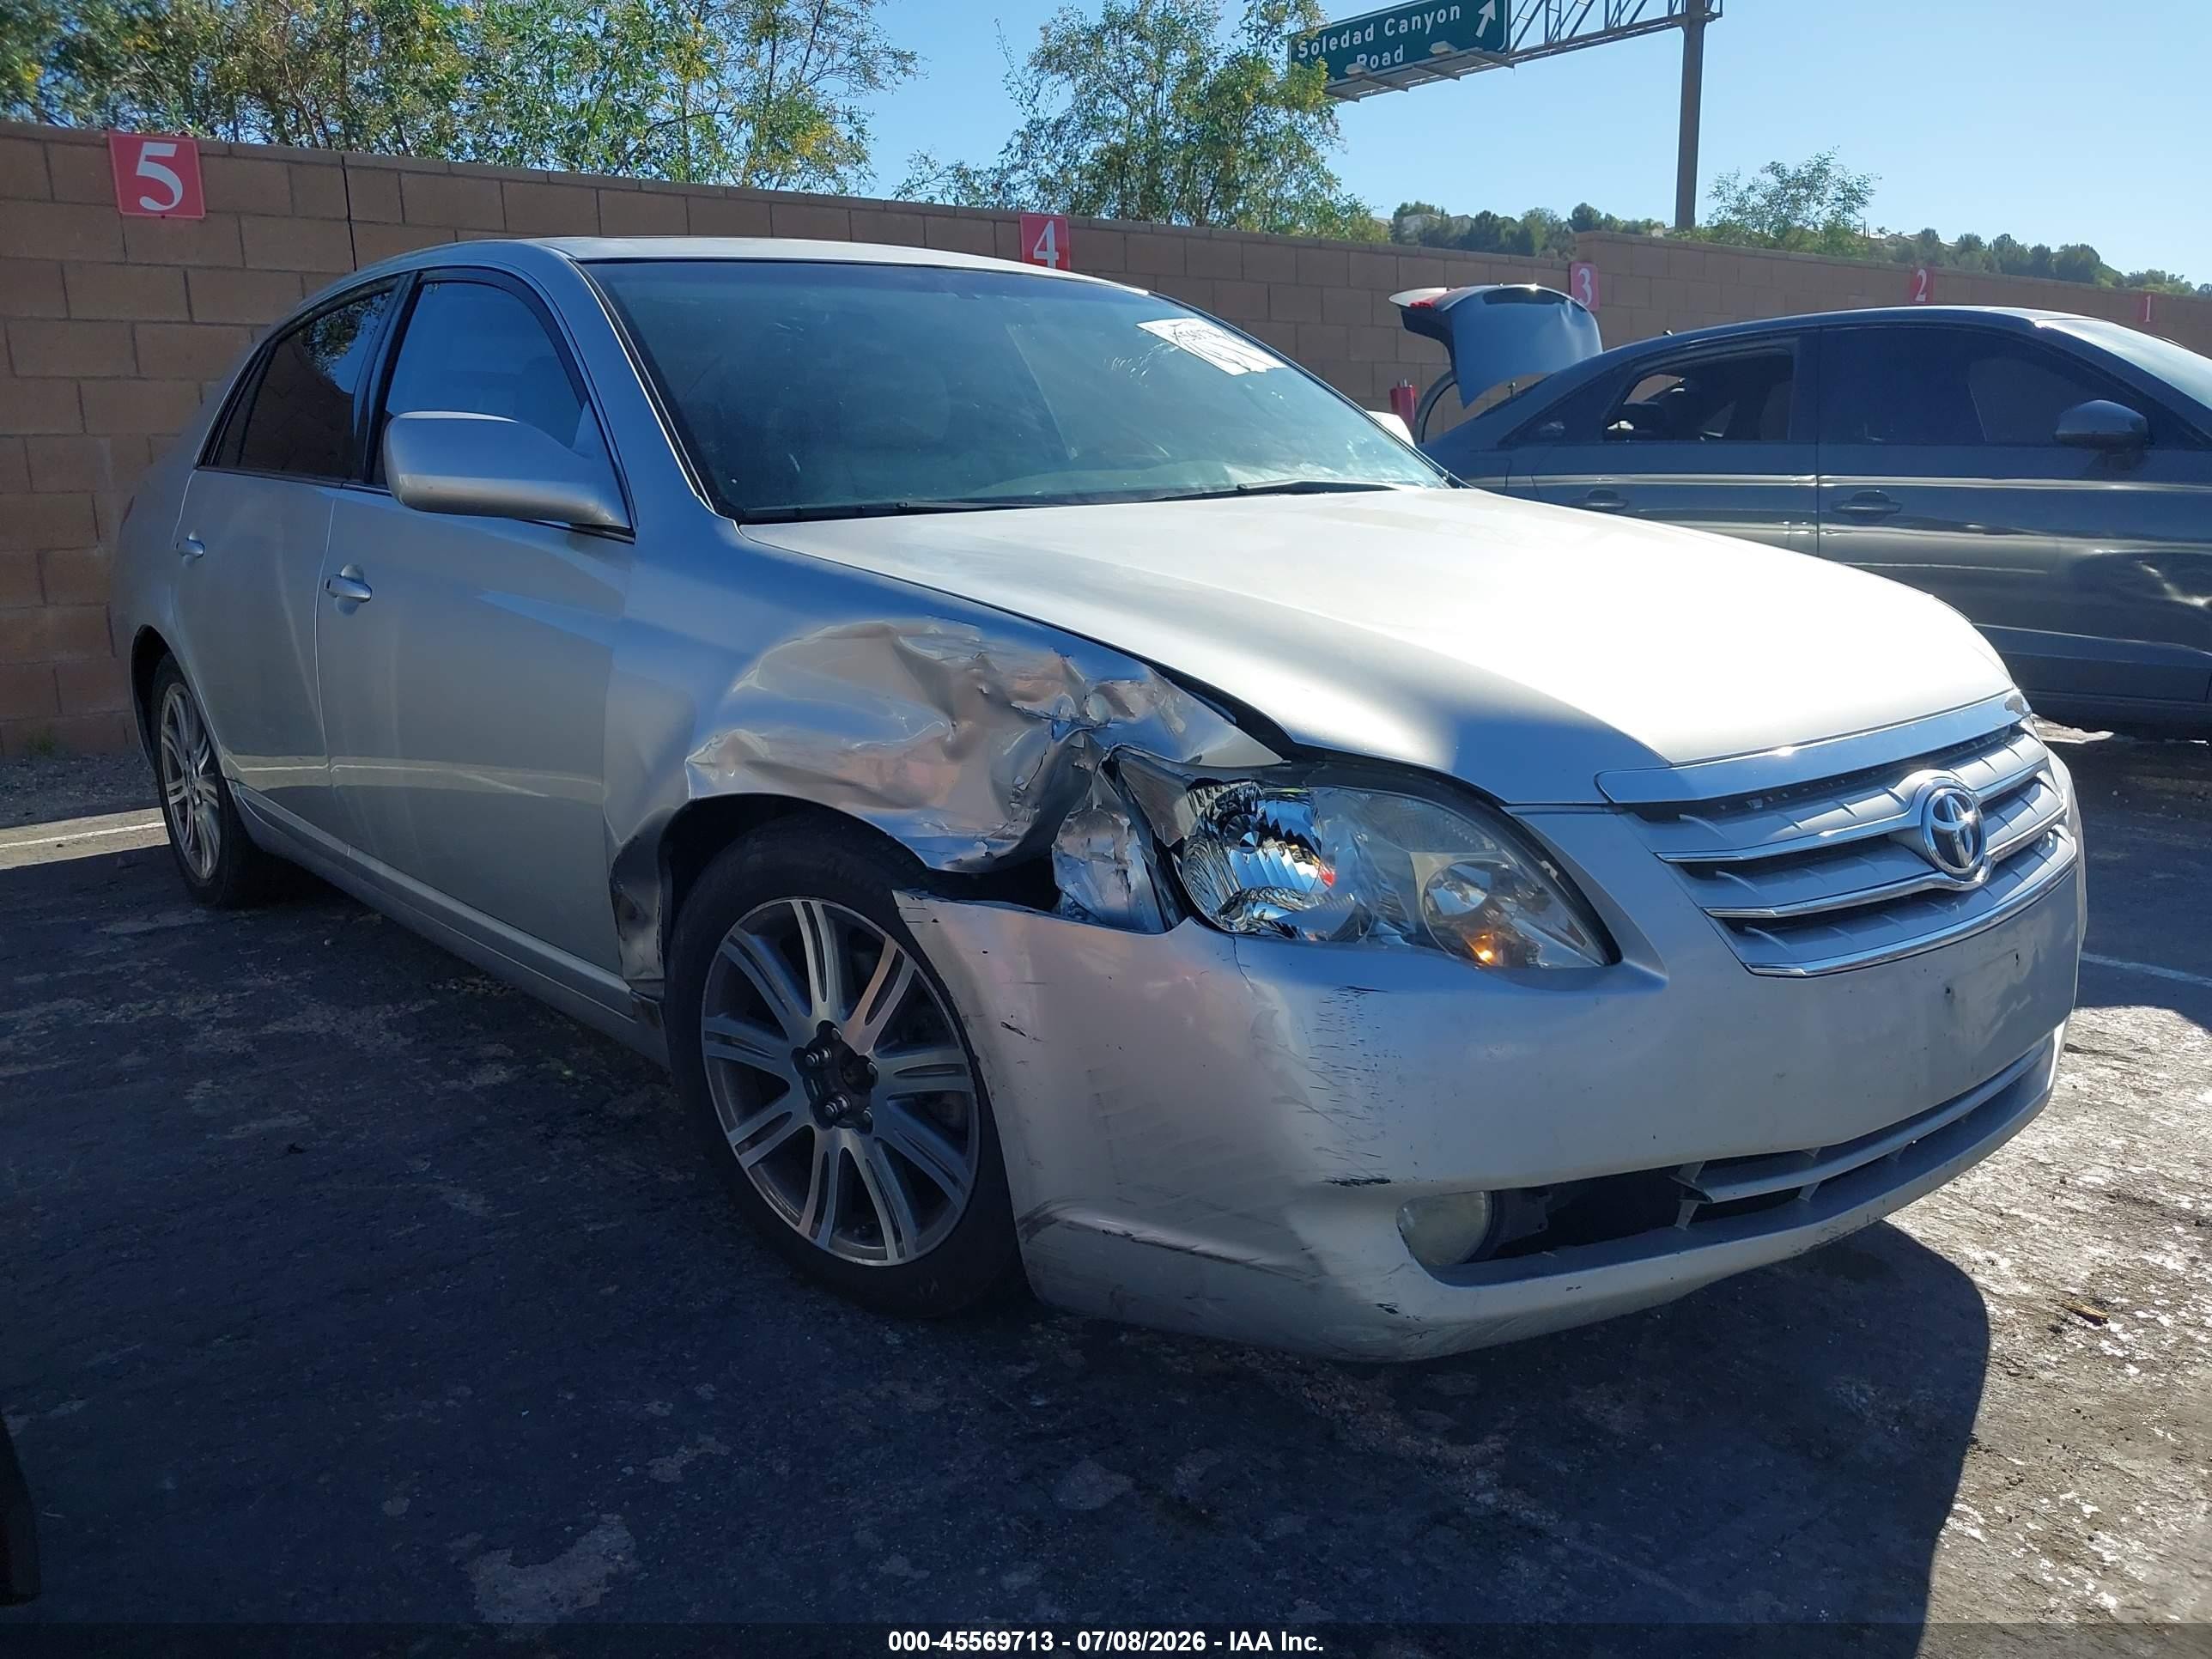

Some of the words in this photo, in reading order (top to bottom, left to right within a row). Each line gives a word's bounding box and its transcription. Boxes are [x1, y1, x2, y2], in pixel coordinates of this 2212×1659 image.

[1297, 23, 1374, 58] Soledad
[1384, 5, 1460, 36] Canyon
[135, 142, 184, 211] 5
[1033, 220, 1060, 269] 4
[1578, 267, 1593, 307] 3
[1915, 268, 1927, 302] 2
[2143, 295, 2151, 323] 1
